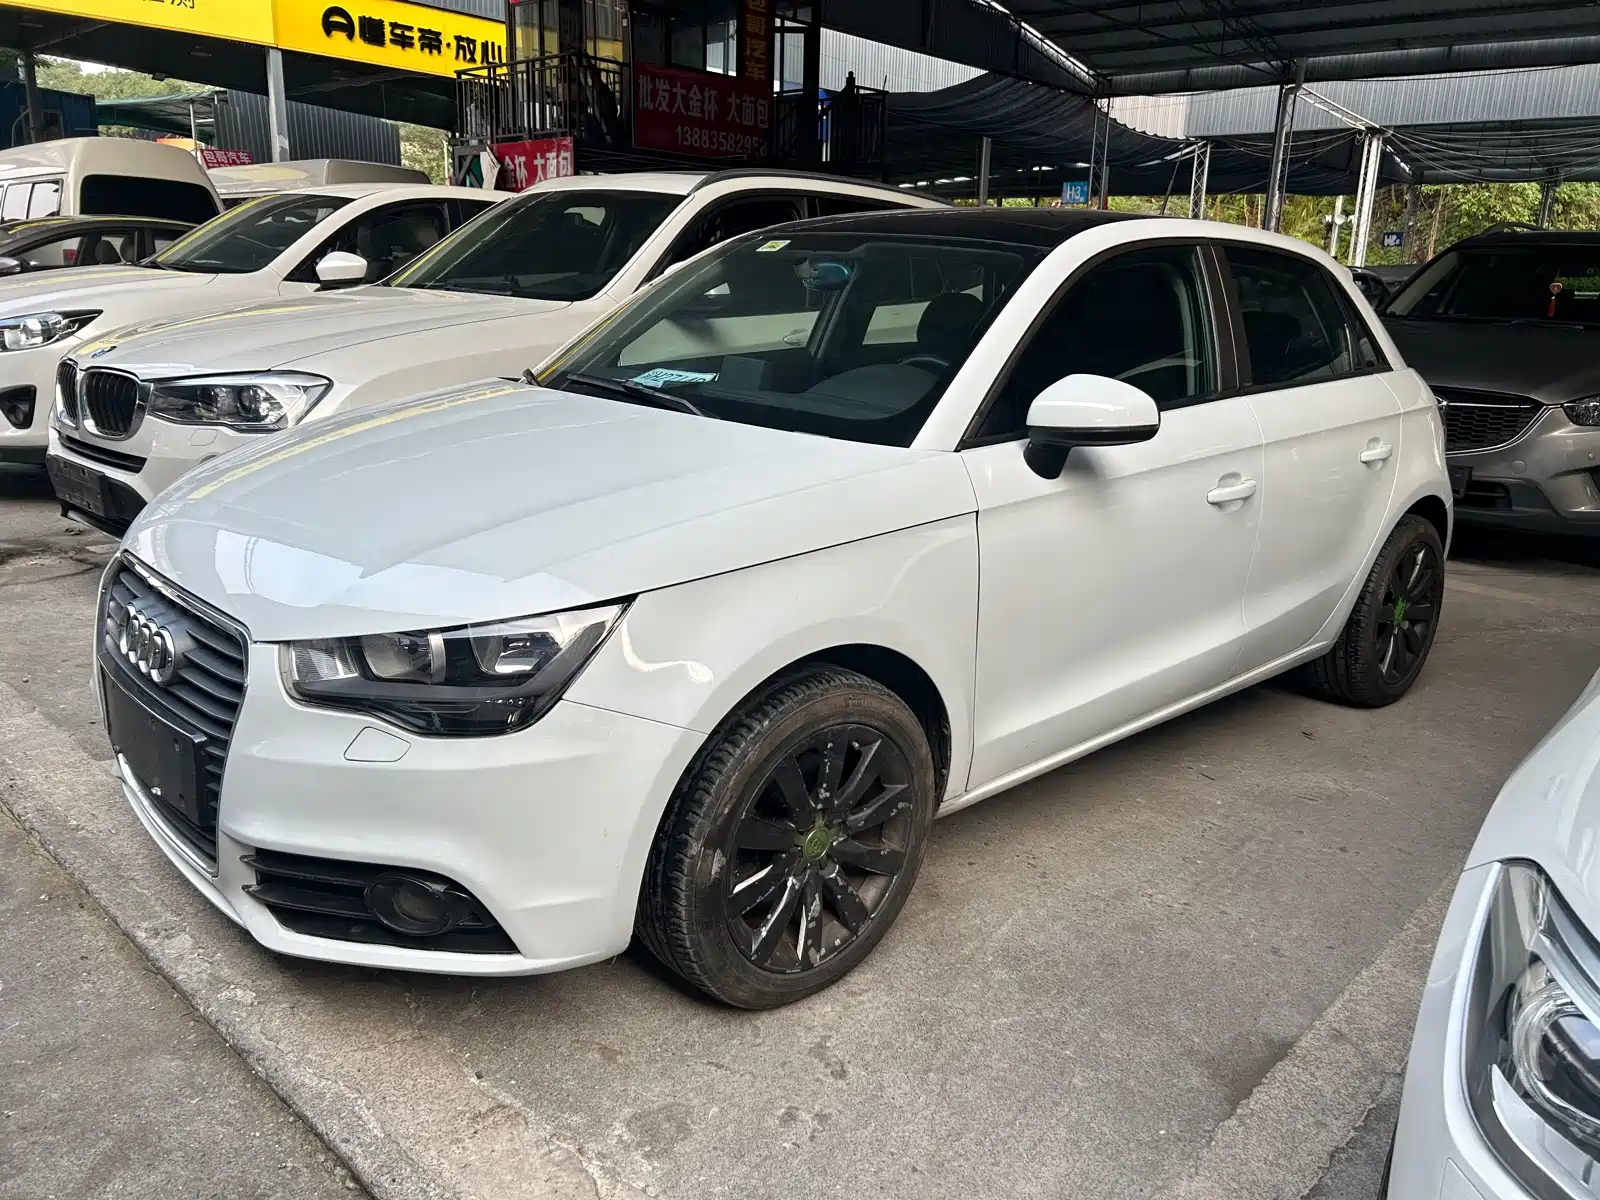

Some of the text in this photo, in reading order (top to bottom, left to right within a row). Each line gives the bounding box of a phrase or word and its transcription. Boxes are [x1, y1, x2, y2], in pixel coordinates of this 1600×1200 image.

[638, 74, 769, 129] 批发大金杯 大面包
[501, 154, 528, 188] 金杯
[1066, 183, 1082, 200] H3
